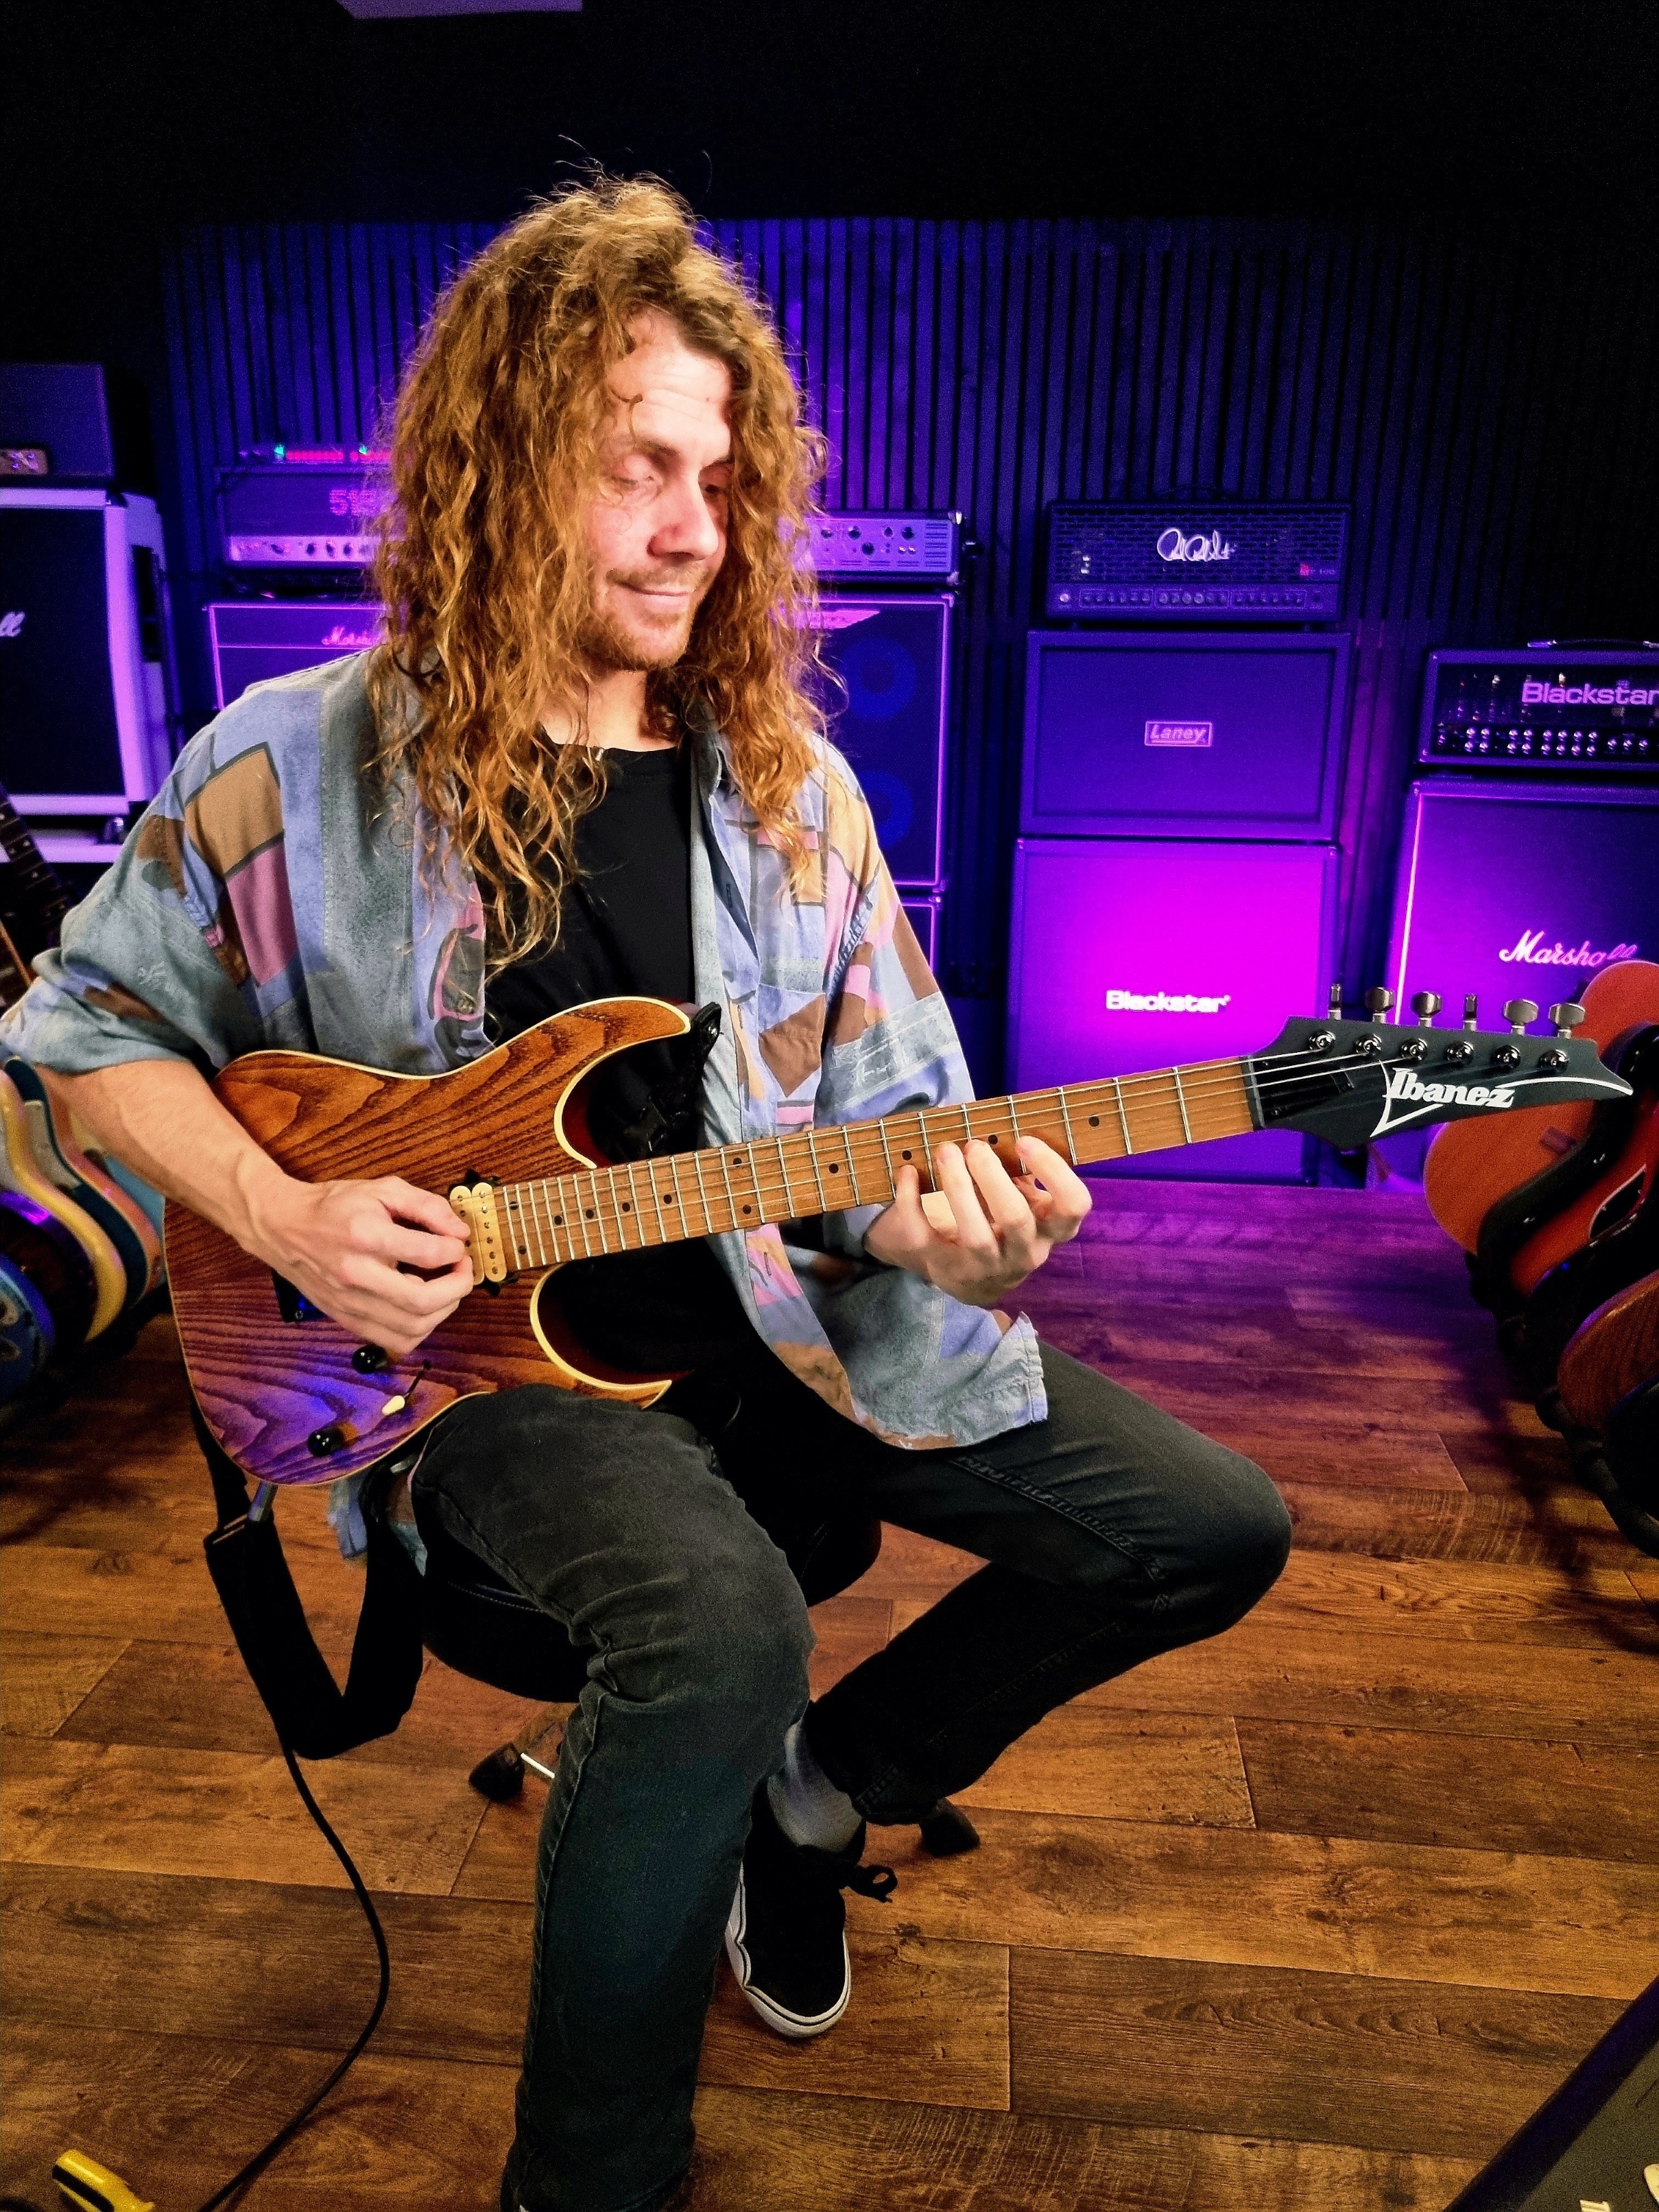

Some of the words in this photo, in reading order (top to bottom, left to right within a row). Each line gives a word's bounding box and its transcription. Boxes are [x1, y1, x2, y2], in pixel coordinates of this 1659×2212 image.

[1522, 682, 1659, 705] Blackstar
[1150, 724, 1206, 745] Laney
[1499, 929, 1638, 967] Marshall
[1106, 990, 1232, 1014] Blackstar
[1382, 1067, 1516, 1108] Ibanez
